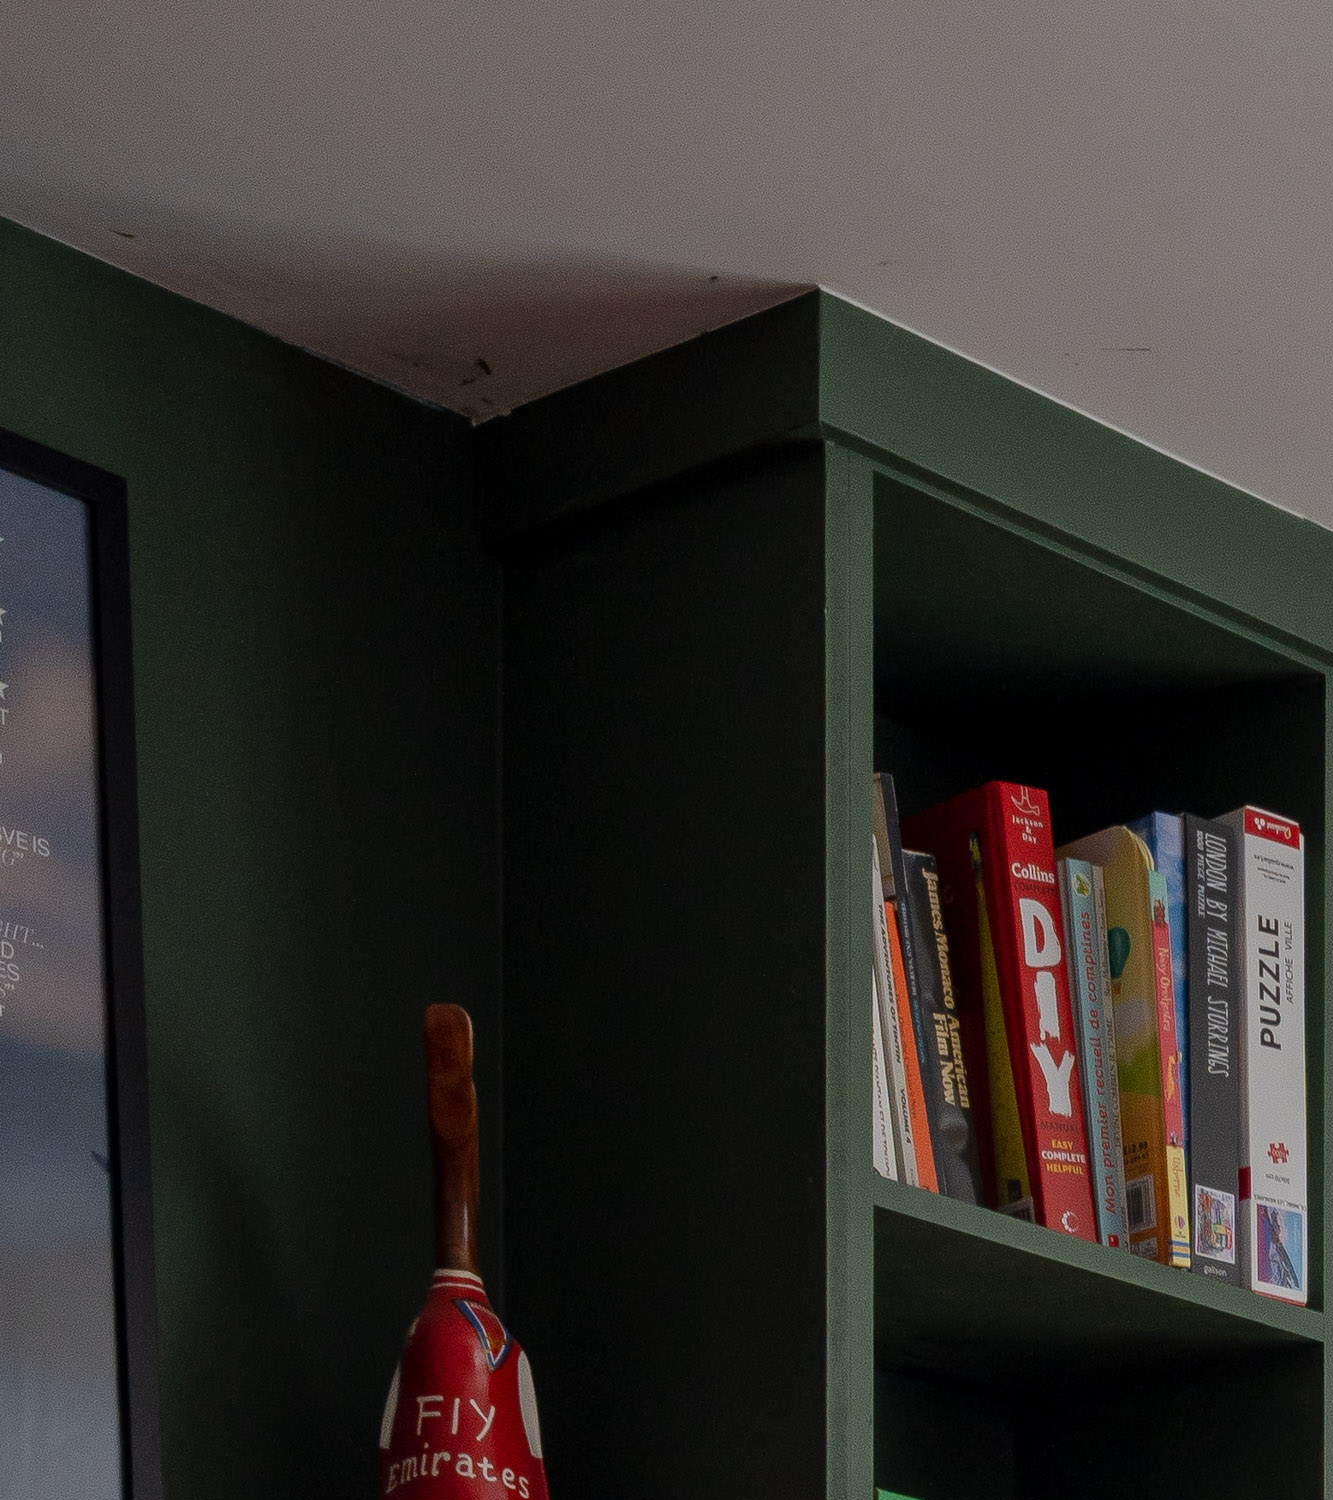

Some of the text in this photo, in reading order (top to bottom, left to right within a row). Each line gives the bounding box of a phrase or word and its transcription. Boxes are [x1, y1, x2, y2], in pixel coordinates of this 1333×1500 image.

[1011, 862, 1055, 884] Collins
[922, 867, 954, 1010] James Monaco
[1205, 832, 1229, 1077] LONDON BY MICHAEL STORRINGS
[1284, 922, 1295, 1005] AFFICHE VILLE
[1019, 898, 1075, 1118] DIY
[1258, 915, 1282, 1051] PUZZLE
[933, 1012, 956, 1107] Film Now
[947, 1013, 970, 1109] American
[1041, 1150, 1086, 1163] COMPLETE
[1046, 1162, 1084, 1175] HELPFUL
[1051, 1139, 1073, 1151] EASY
[416, 1395, 496, 1441] Fly
[385, 1442, 530, 1500] Emirates
